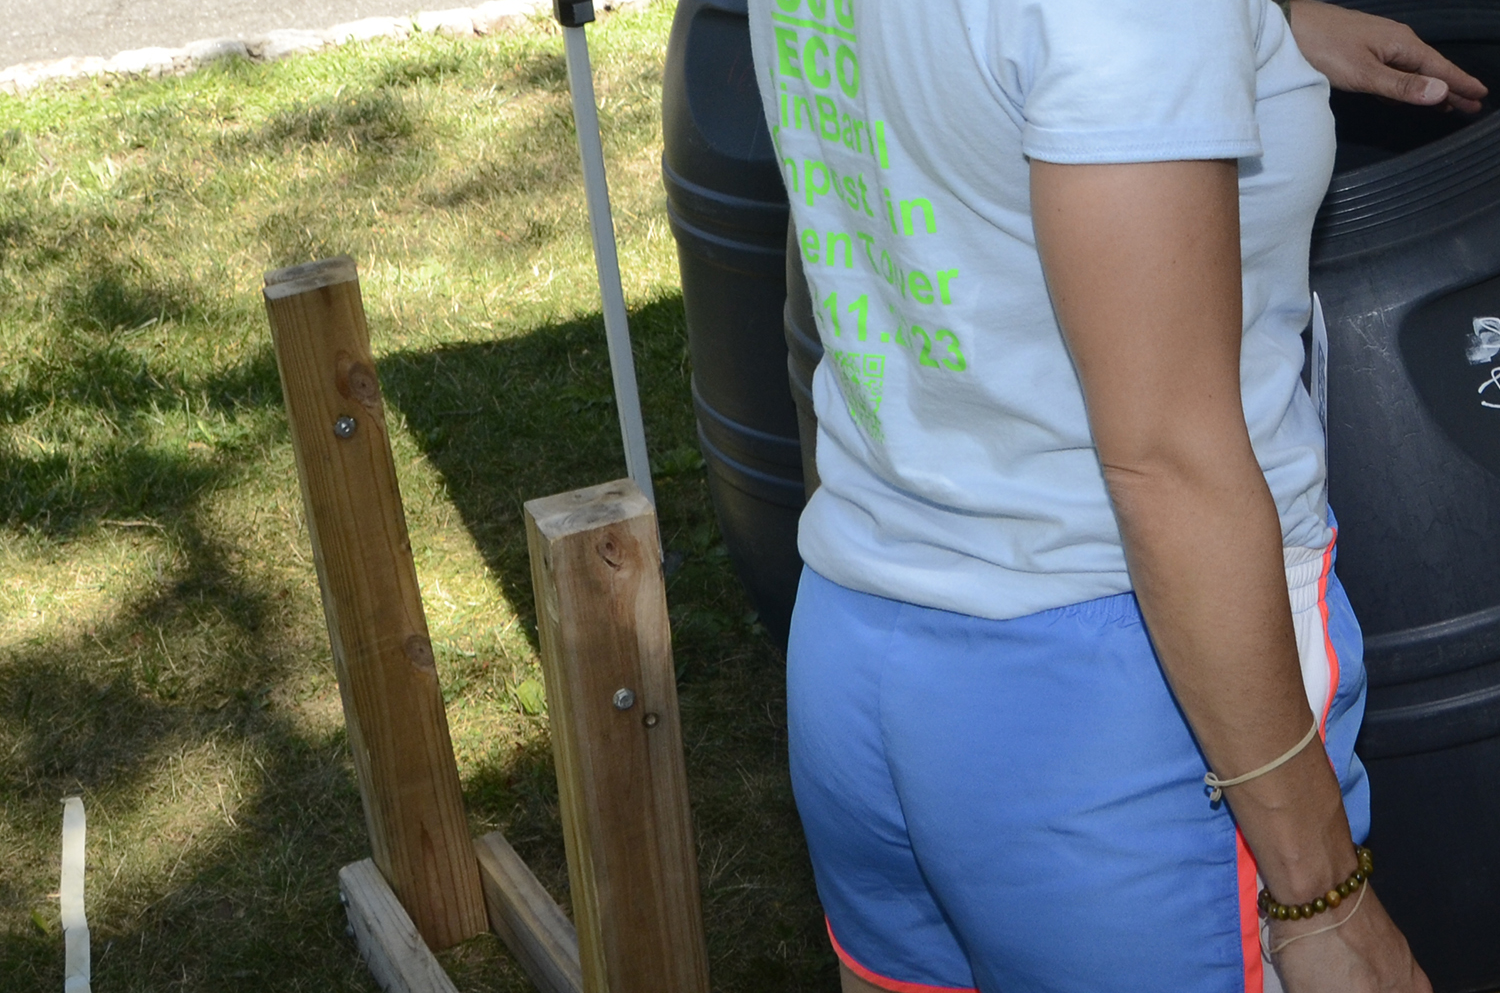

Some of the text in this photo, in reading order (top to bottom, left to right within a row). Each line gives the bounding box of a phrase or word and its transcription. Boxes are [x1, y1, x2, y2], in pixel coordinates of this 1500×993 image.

[774, 26, 860, 99] ECO
[883, 187, 937, 236] in
[857, 231, 959, 305] Toer
